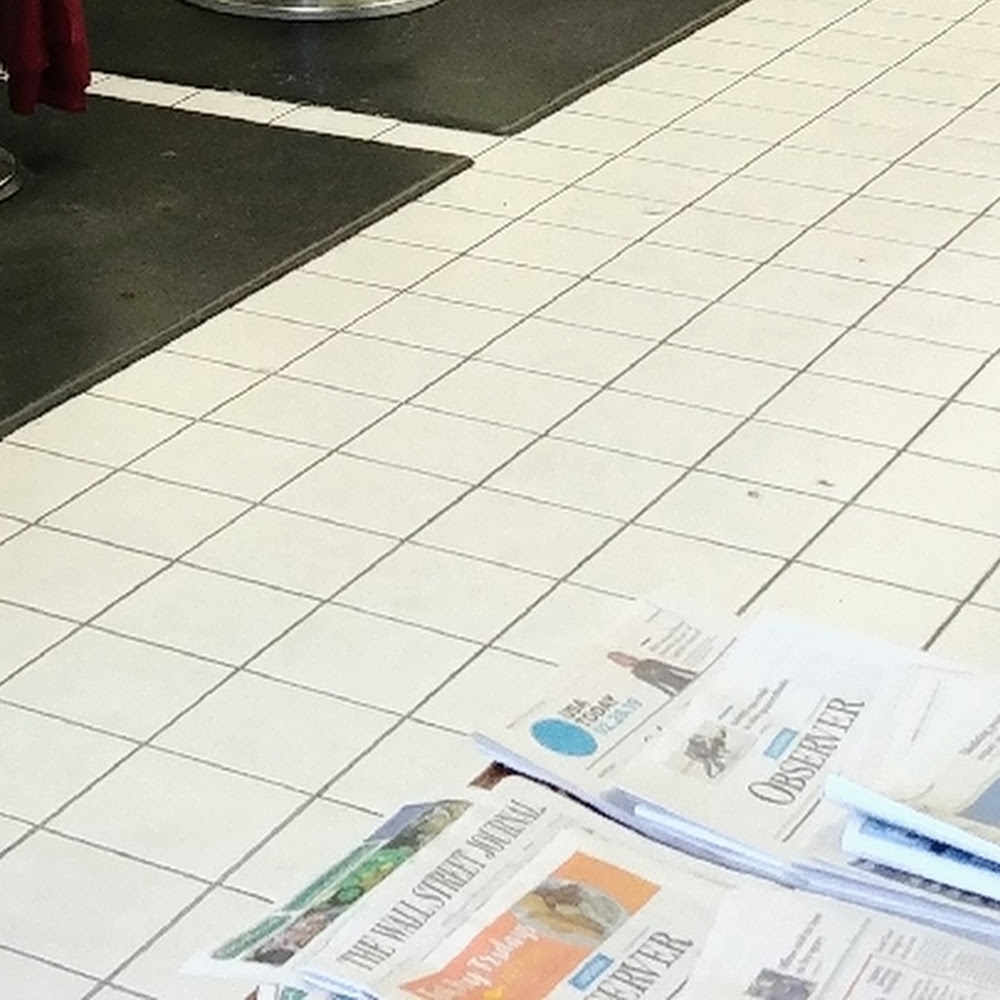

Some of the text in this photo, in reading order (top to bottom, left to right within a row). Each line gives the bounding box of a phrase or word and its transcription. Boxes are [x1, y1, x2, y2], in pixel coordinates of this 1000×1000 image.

[748, 696, 865, 806] OBSERVER
[336, 934, 397, 972] THE
[370, 900, 435, 945] WALL
[411, 847, 489, 909] STREET
[584, 931, 694, 1000] ERVER
